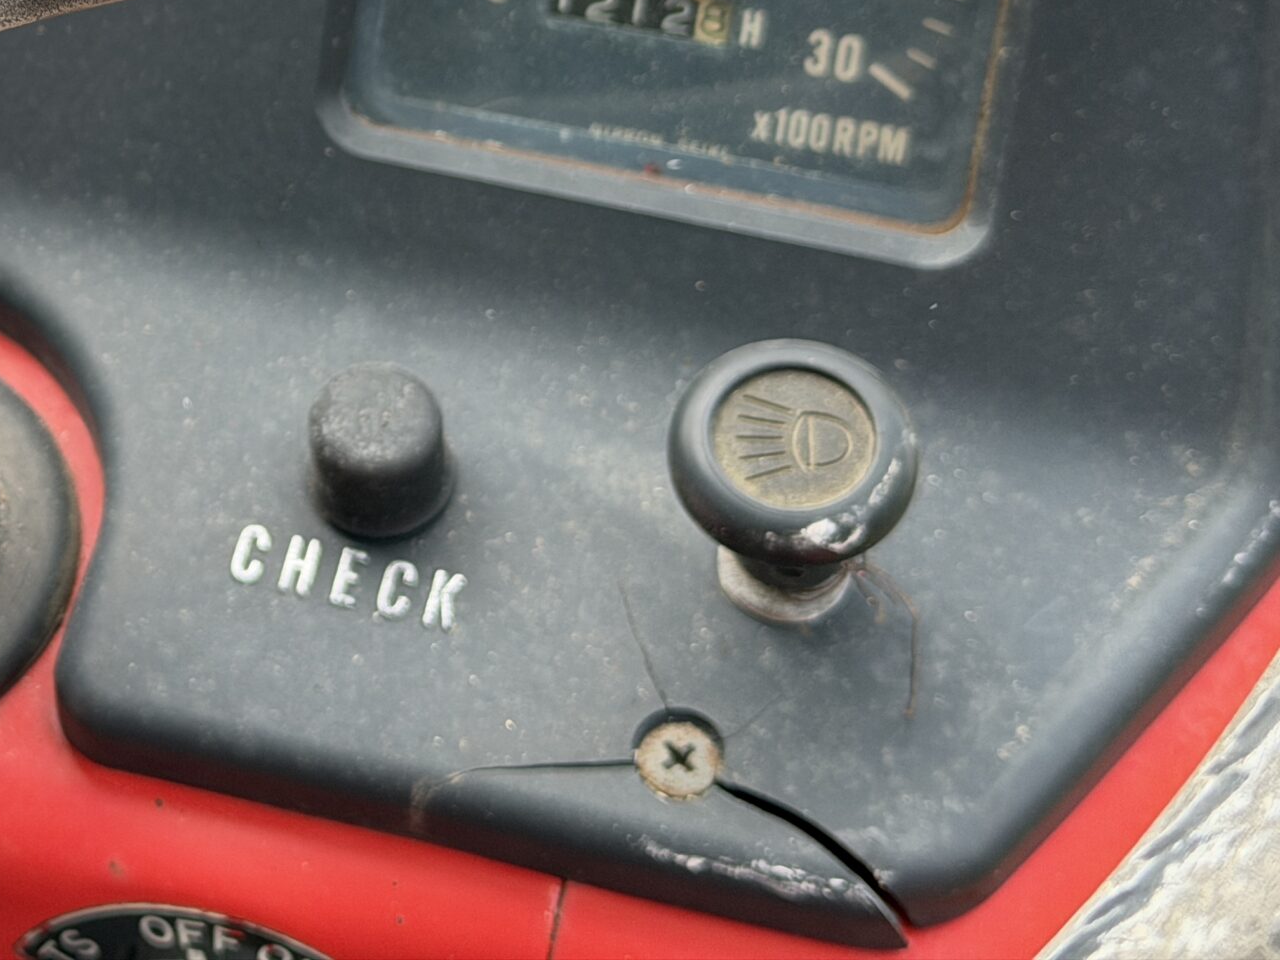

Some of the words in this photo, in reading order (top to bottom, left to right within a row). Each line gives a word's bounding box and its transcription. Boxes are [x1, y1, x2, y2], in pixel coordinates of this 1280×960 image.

[738, 7, 767, 50] H
[802, 28, 863, 83] 30
[229, 524, 468, 632] CHECK
[138, 914, 246, 953] OFF
